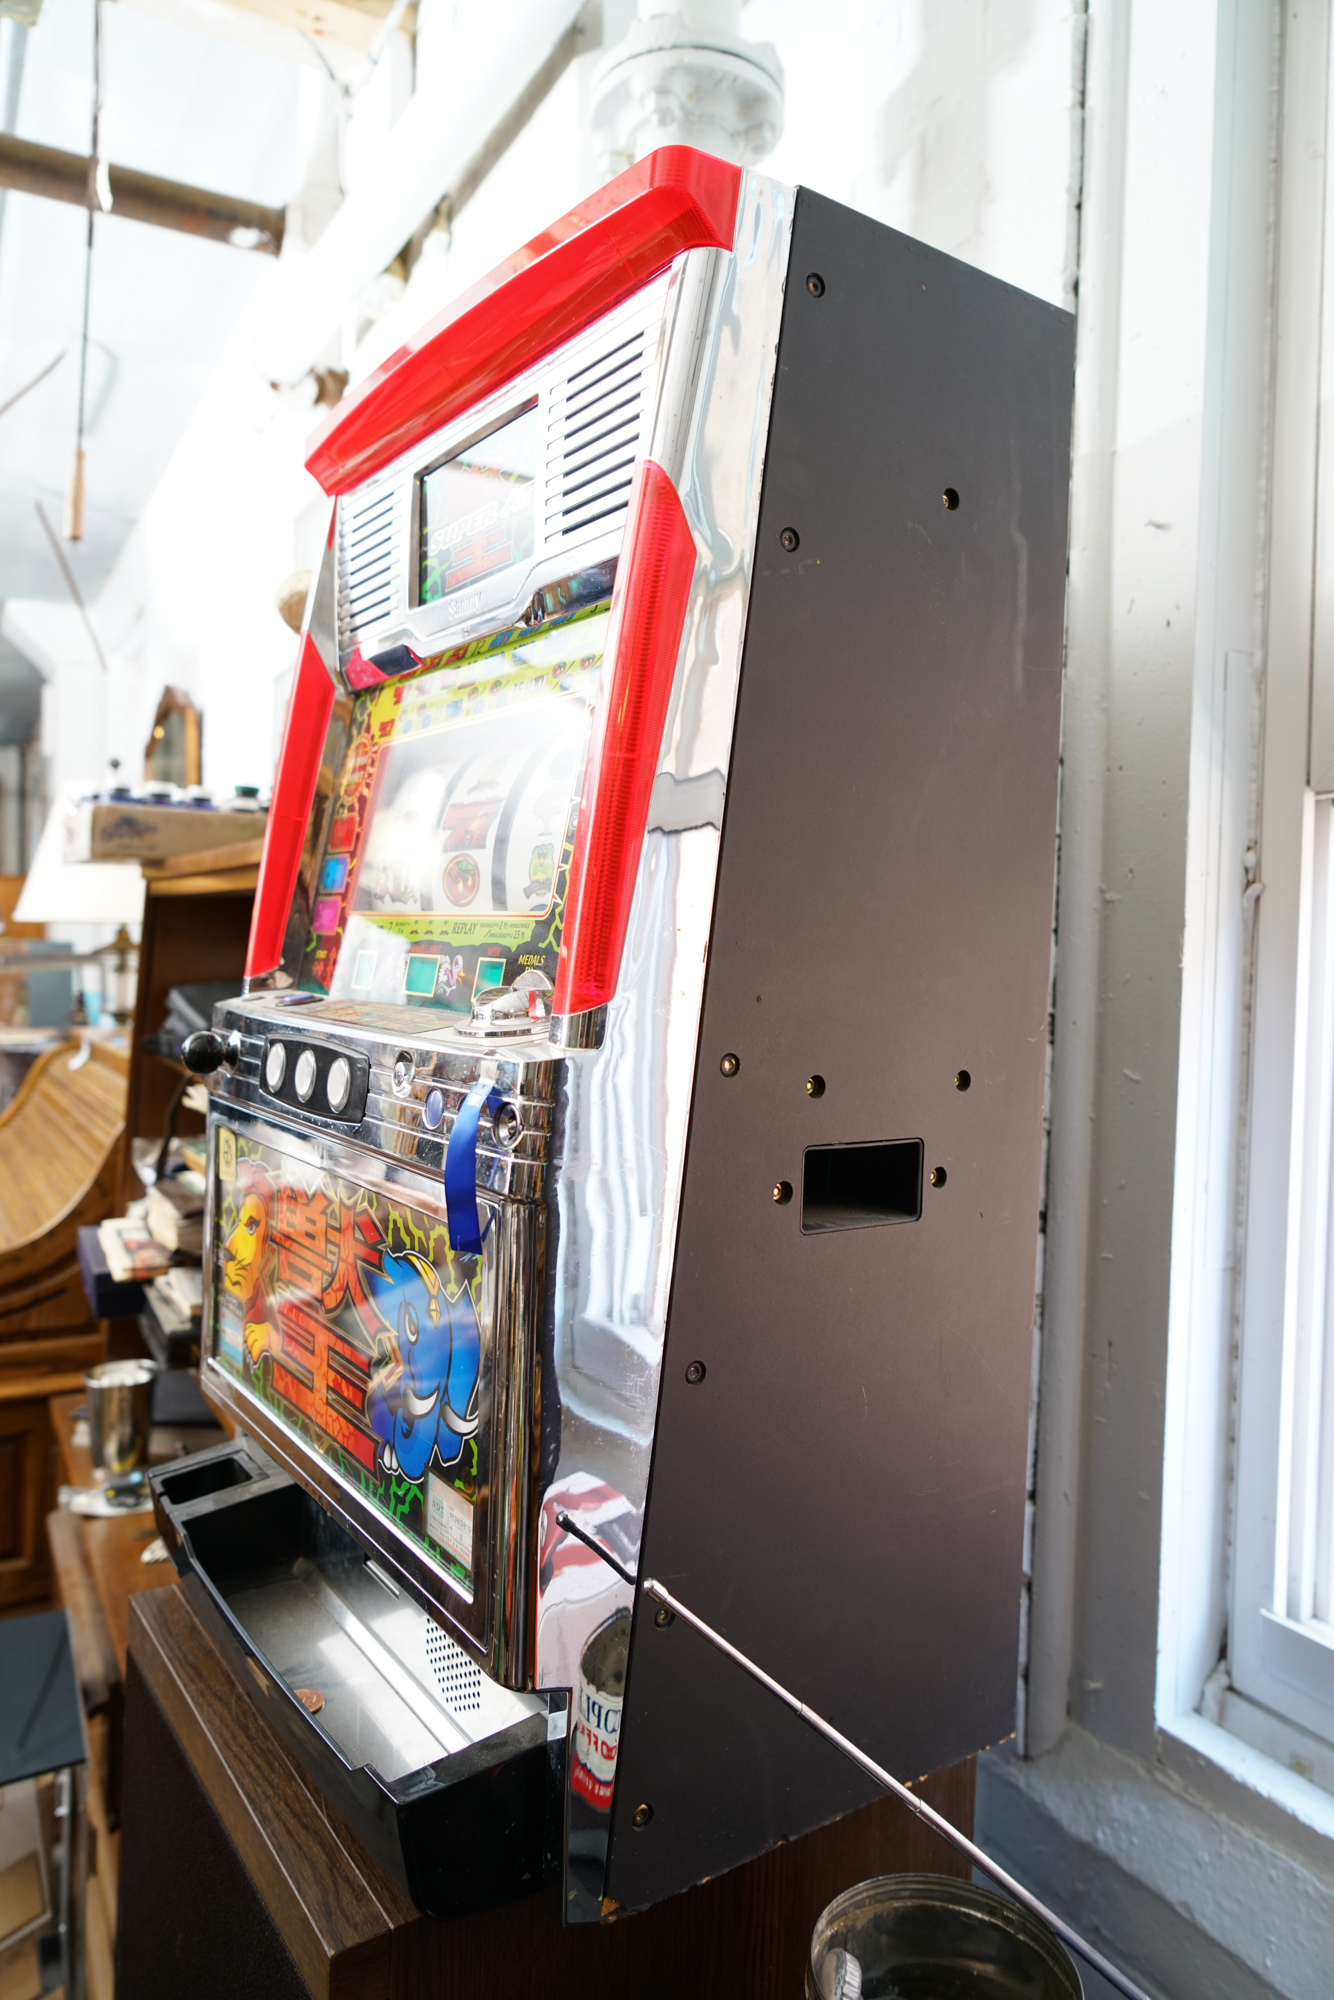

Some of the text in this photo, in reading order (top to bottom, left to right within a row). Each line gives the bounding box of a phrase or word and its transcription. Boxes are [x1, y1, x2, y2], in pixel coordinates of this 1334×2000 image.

[428, 500, 499, 557] SUPER
[448, 591, 482, 621] Sammy
[451, 922, 479, 935] REPLAY
[487, 947, 502, 957] WIN
[518, 954, 546, 966] MEDALS
[432, 1498, 444, 1515] NDT
